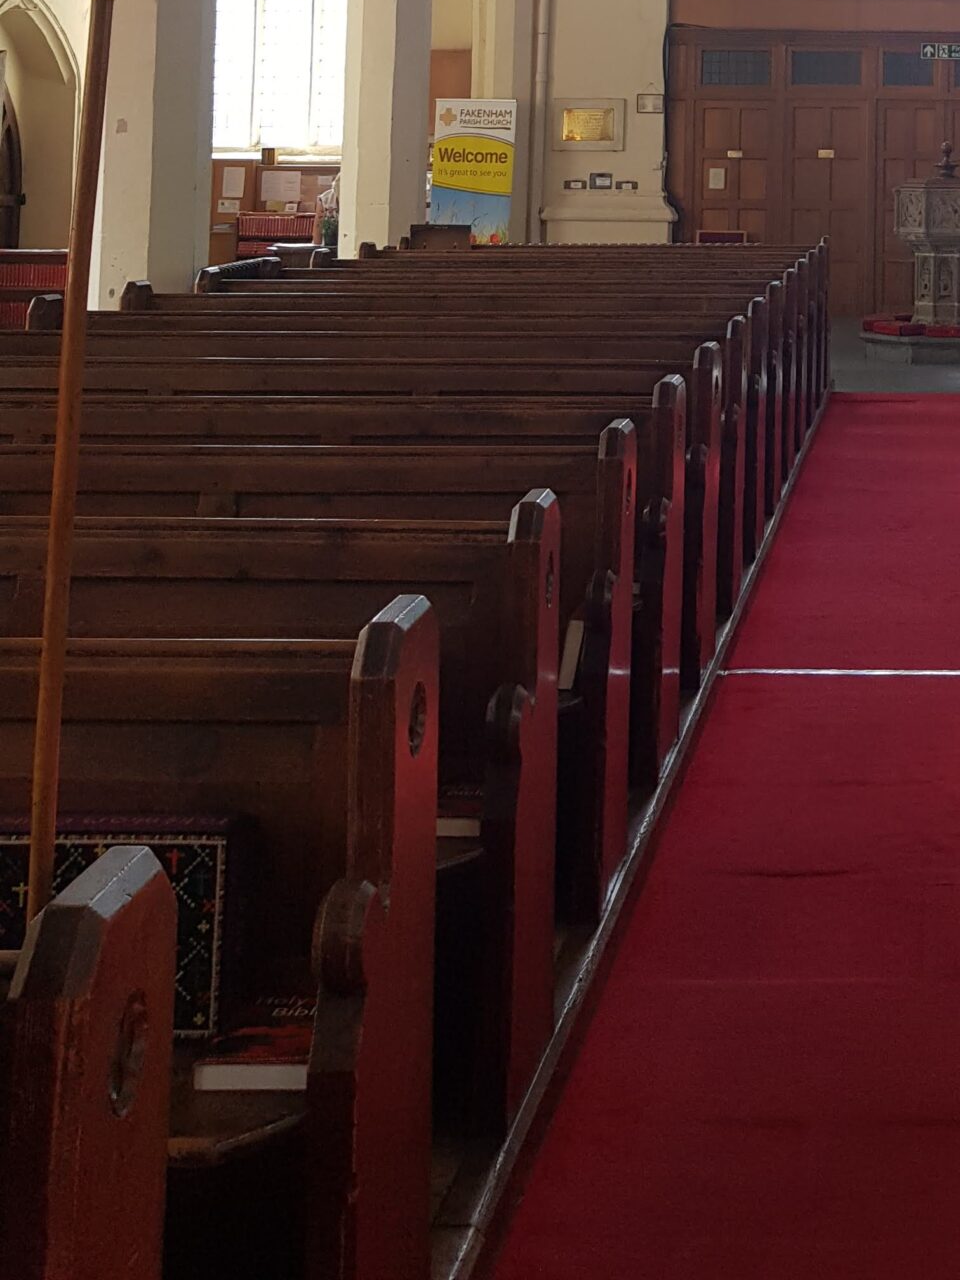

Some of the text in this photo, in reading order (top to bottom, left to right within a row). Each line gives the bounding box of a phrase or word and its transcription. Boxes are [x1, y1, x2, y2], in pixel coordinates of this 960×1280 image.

[460, 108, 512, 118] FAKENHAM
[438, 147, 508, 163] Welcome
[449, 169, 468, 177] great
[256, 995, 310, 1010] Holy
[271, 1006, 316, 1017] Bibl
